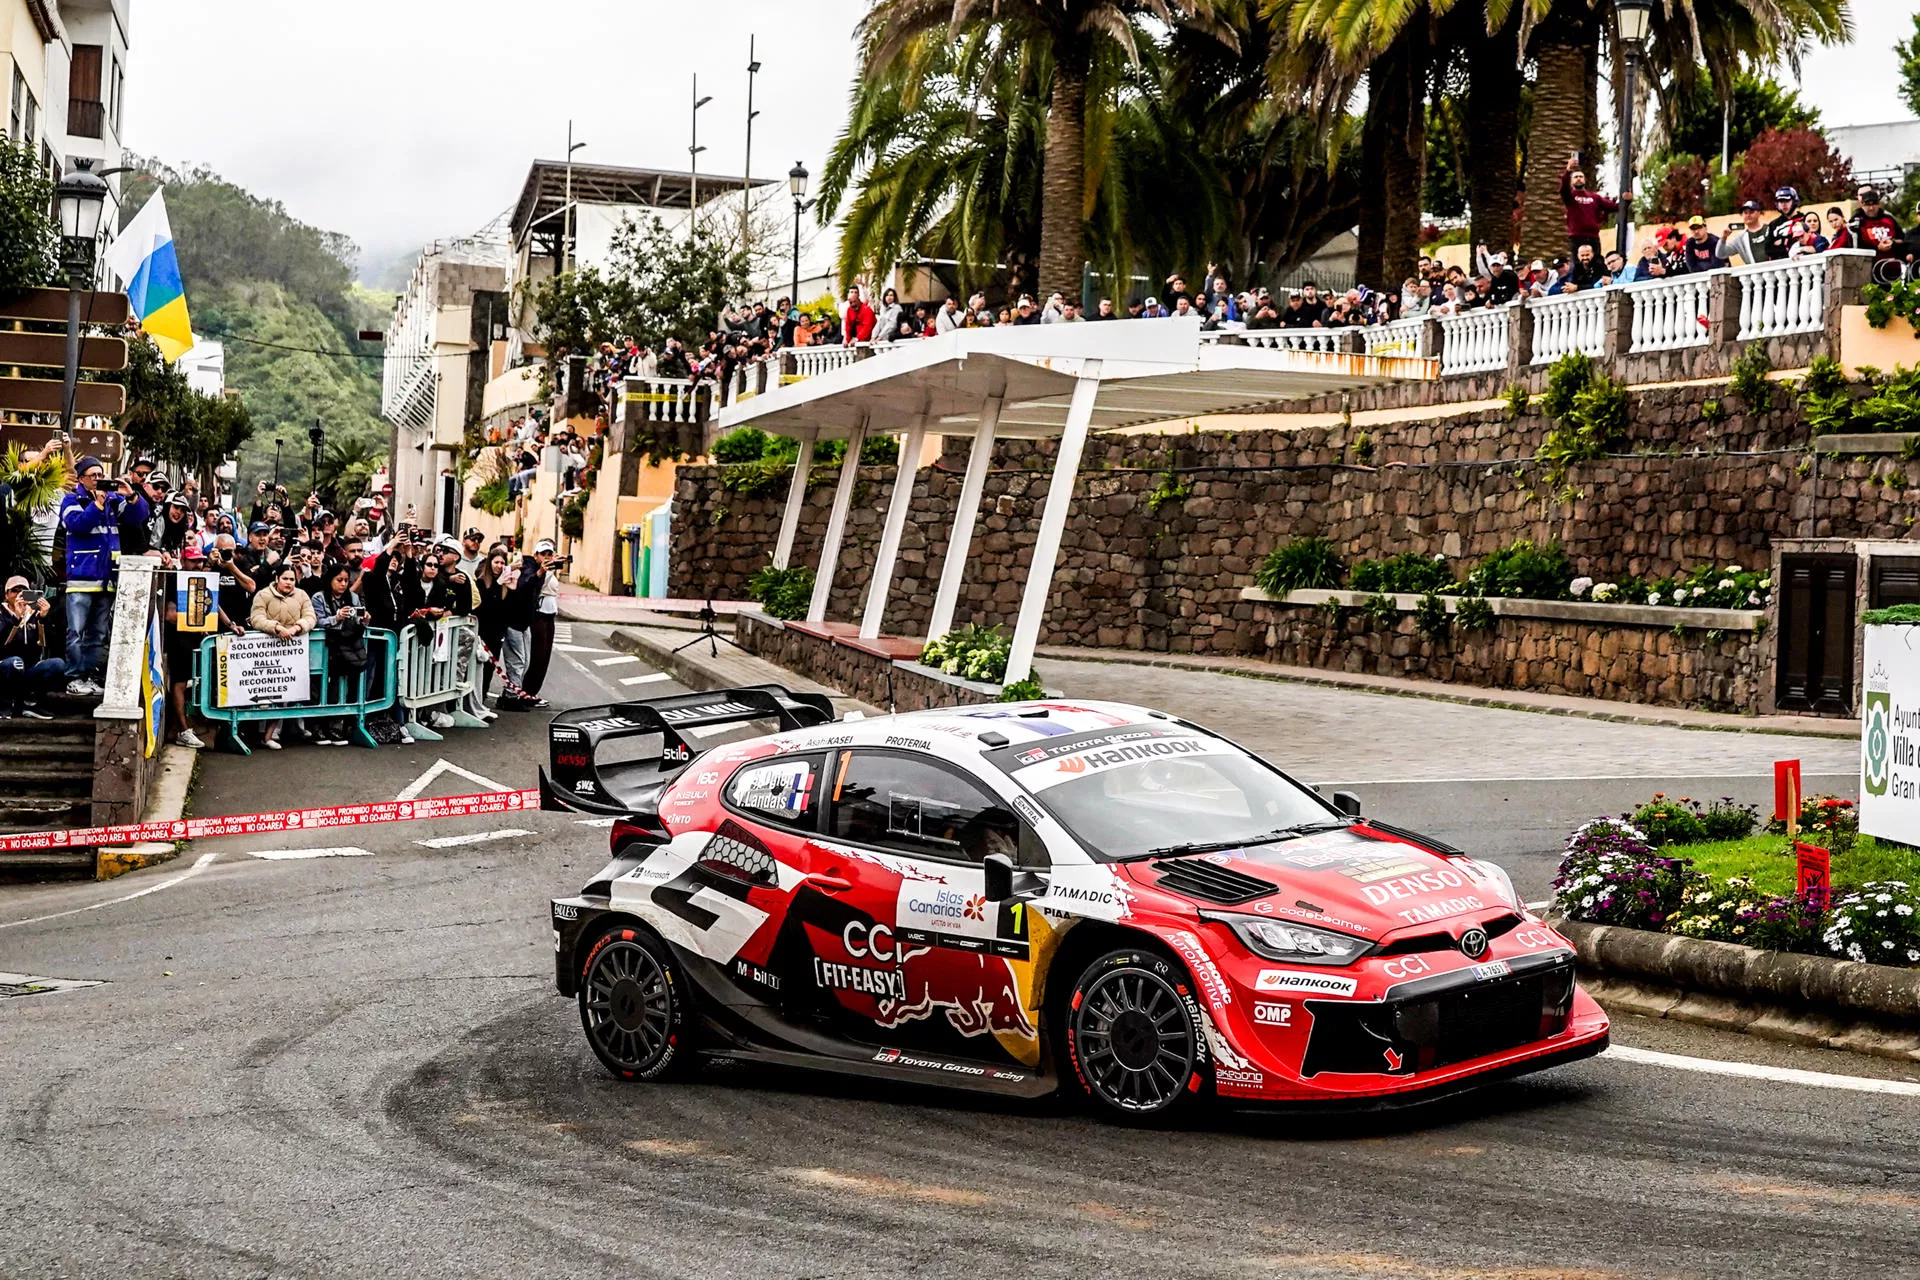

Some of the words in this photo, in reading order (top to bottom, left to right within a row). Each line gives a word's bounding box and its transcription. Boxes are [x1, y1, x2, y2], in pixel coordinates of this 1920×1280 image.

[230, 649, 304, 659] RECONOCIMIENTO
[239, 676, 296, 686] RECOGNITION
[248, 685, 288, 694] VEHICLES
[885, 736, 931, 750] PROTERIAL
[1048, 738, 1105, 754] TOYOTA
[664, 743, 689, 761] Stilo
[1894, 736, 1913, 767] Villa
[558, 755, 586, 766] DENSO
[833, 751, 852, 801] 1
[1892, 772, 1914, 800] Gran
[449, 797, 479, 805] PROHIBIDO
[338, 806, 370, 815] PROHIBIDO
[372, 804, 397, 813] PUBLICO
[430, 808, 449, 816] NO-GO
[450, 806, 465, 815] AREA
[479, 803, 504, 811] GO-AREA
[1014, 798, 1040, 824] CENTRAL
[224, 815, 256, 824] PROHIBIDO
[260, 813, 285, 821] PUBLICO
[320, 817, 338, 825] NO-GO
[340, 816, 356, 824] AREA
[370, 812, 396, 821] GO-AREA
[107, 824, 140, 832] PROHIBIDO
[205, 826, 224, 835] NO-GO
[226, 825, 242, 834] AREA
[256, 822, 284, 830] GO-AREA
[21, 838, 50, 848] GO-AREA
[88, 834, 108, 843] NO-GO
[109, 833, 126, 842] AREA
[130, 832, 140, 840] NO
[141, 830, 168, 839] GO-AREA
[644, 869, 670, 880] Microsoft
[1054, 886, 1112, 904] TAMADIC
[1360, 869, 1463, 906] DENSO
[937, 889, 964, 905] Islas
[910, 899, 962, 918] Canarias
[1044, 907, 1071, 919] PIAA
[1398, 896, 1484, 925] TAMADIC
[1010, 902, 1023, 934] 1
[1280, 907, 1369, 933] codebeamer
[738, 961, 767, 984] Mobil
[1164, 934, 1223, 1010] AUTOMOTIVE
[1176, 930, 1232, 1005] Panasonic
[1254, 1005, 1291, 1022] OMP
[898, 1056, 942, 1069] TOYOTA
[942, 1063, 985, 1075] GAZOO
[985, 1069, 1024, 1082] Racing
